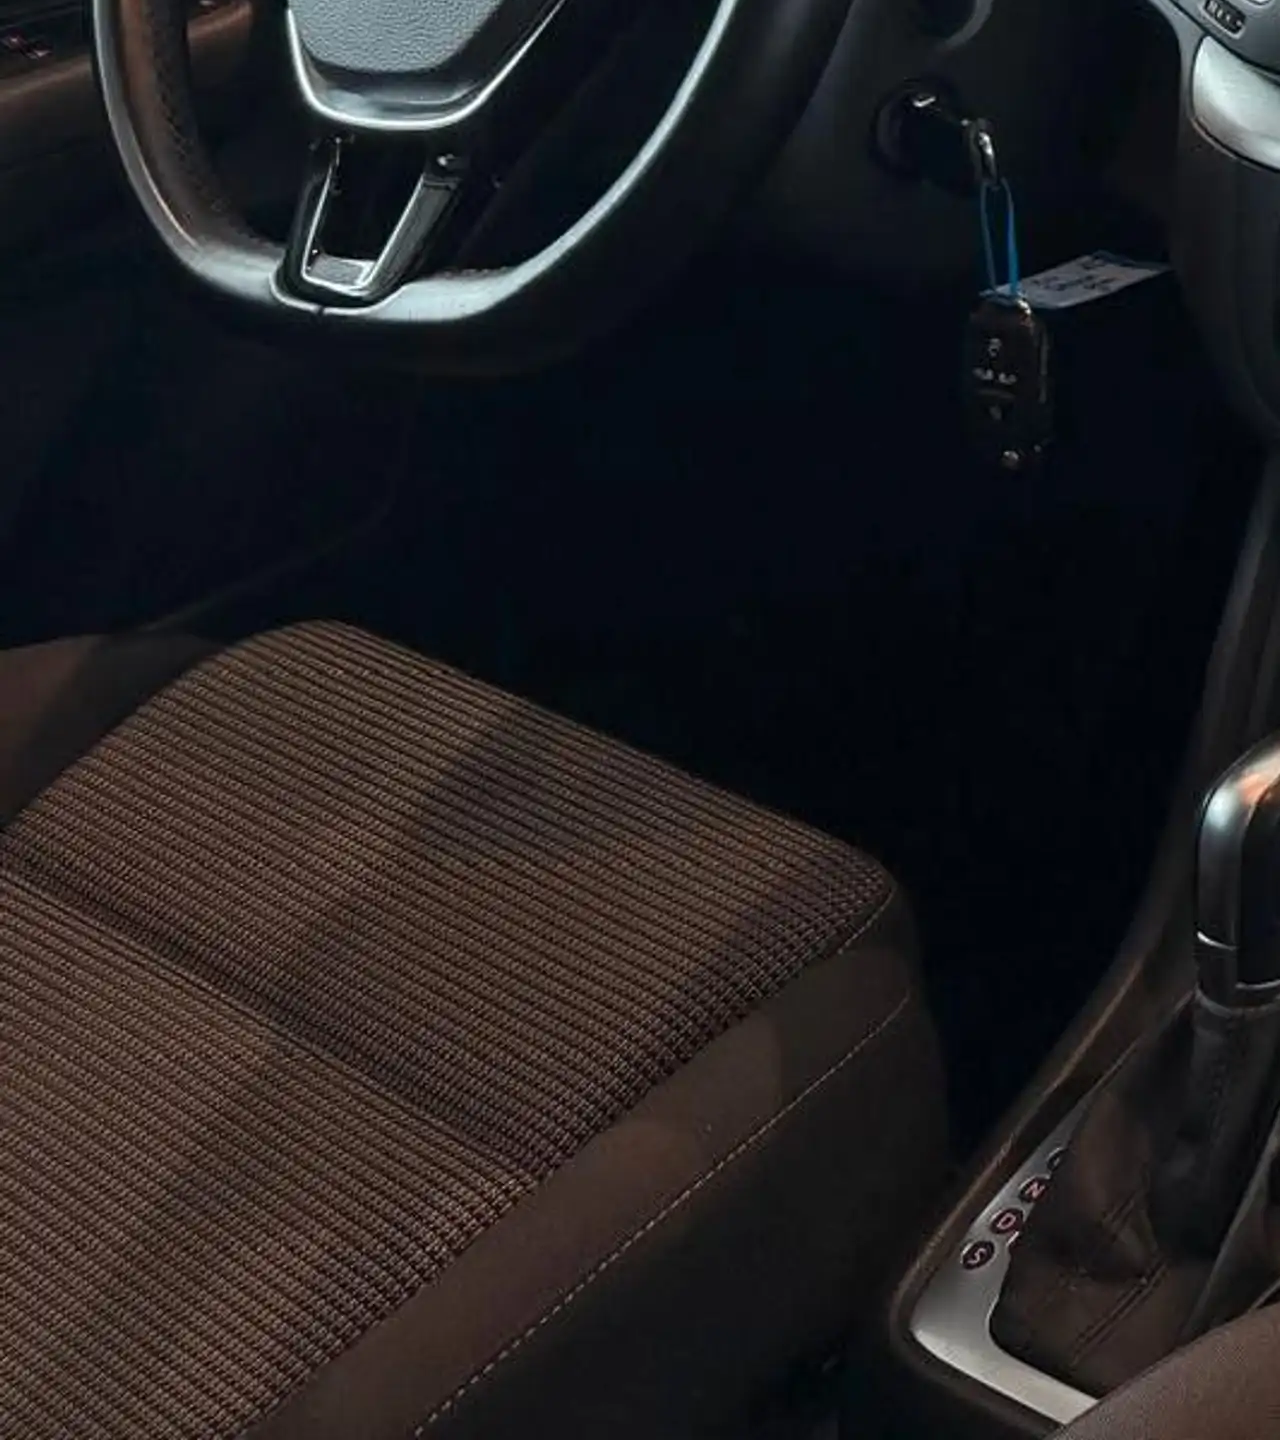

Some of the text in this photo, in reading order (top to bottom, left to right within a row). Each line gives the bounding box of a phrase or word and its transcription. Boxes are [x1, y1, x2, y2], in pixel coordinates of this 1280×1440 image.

[1025, 1182, 1045, 1198] N
[997, 1213, 1015, 1229] D
[967, 1248, 986, 1264] S
